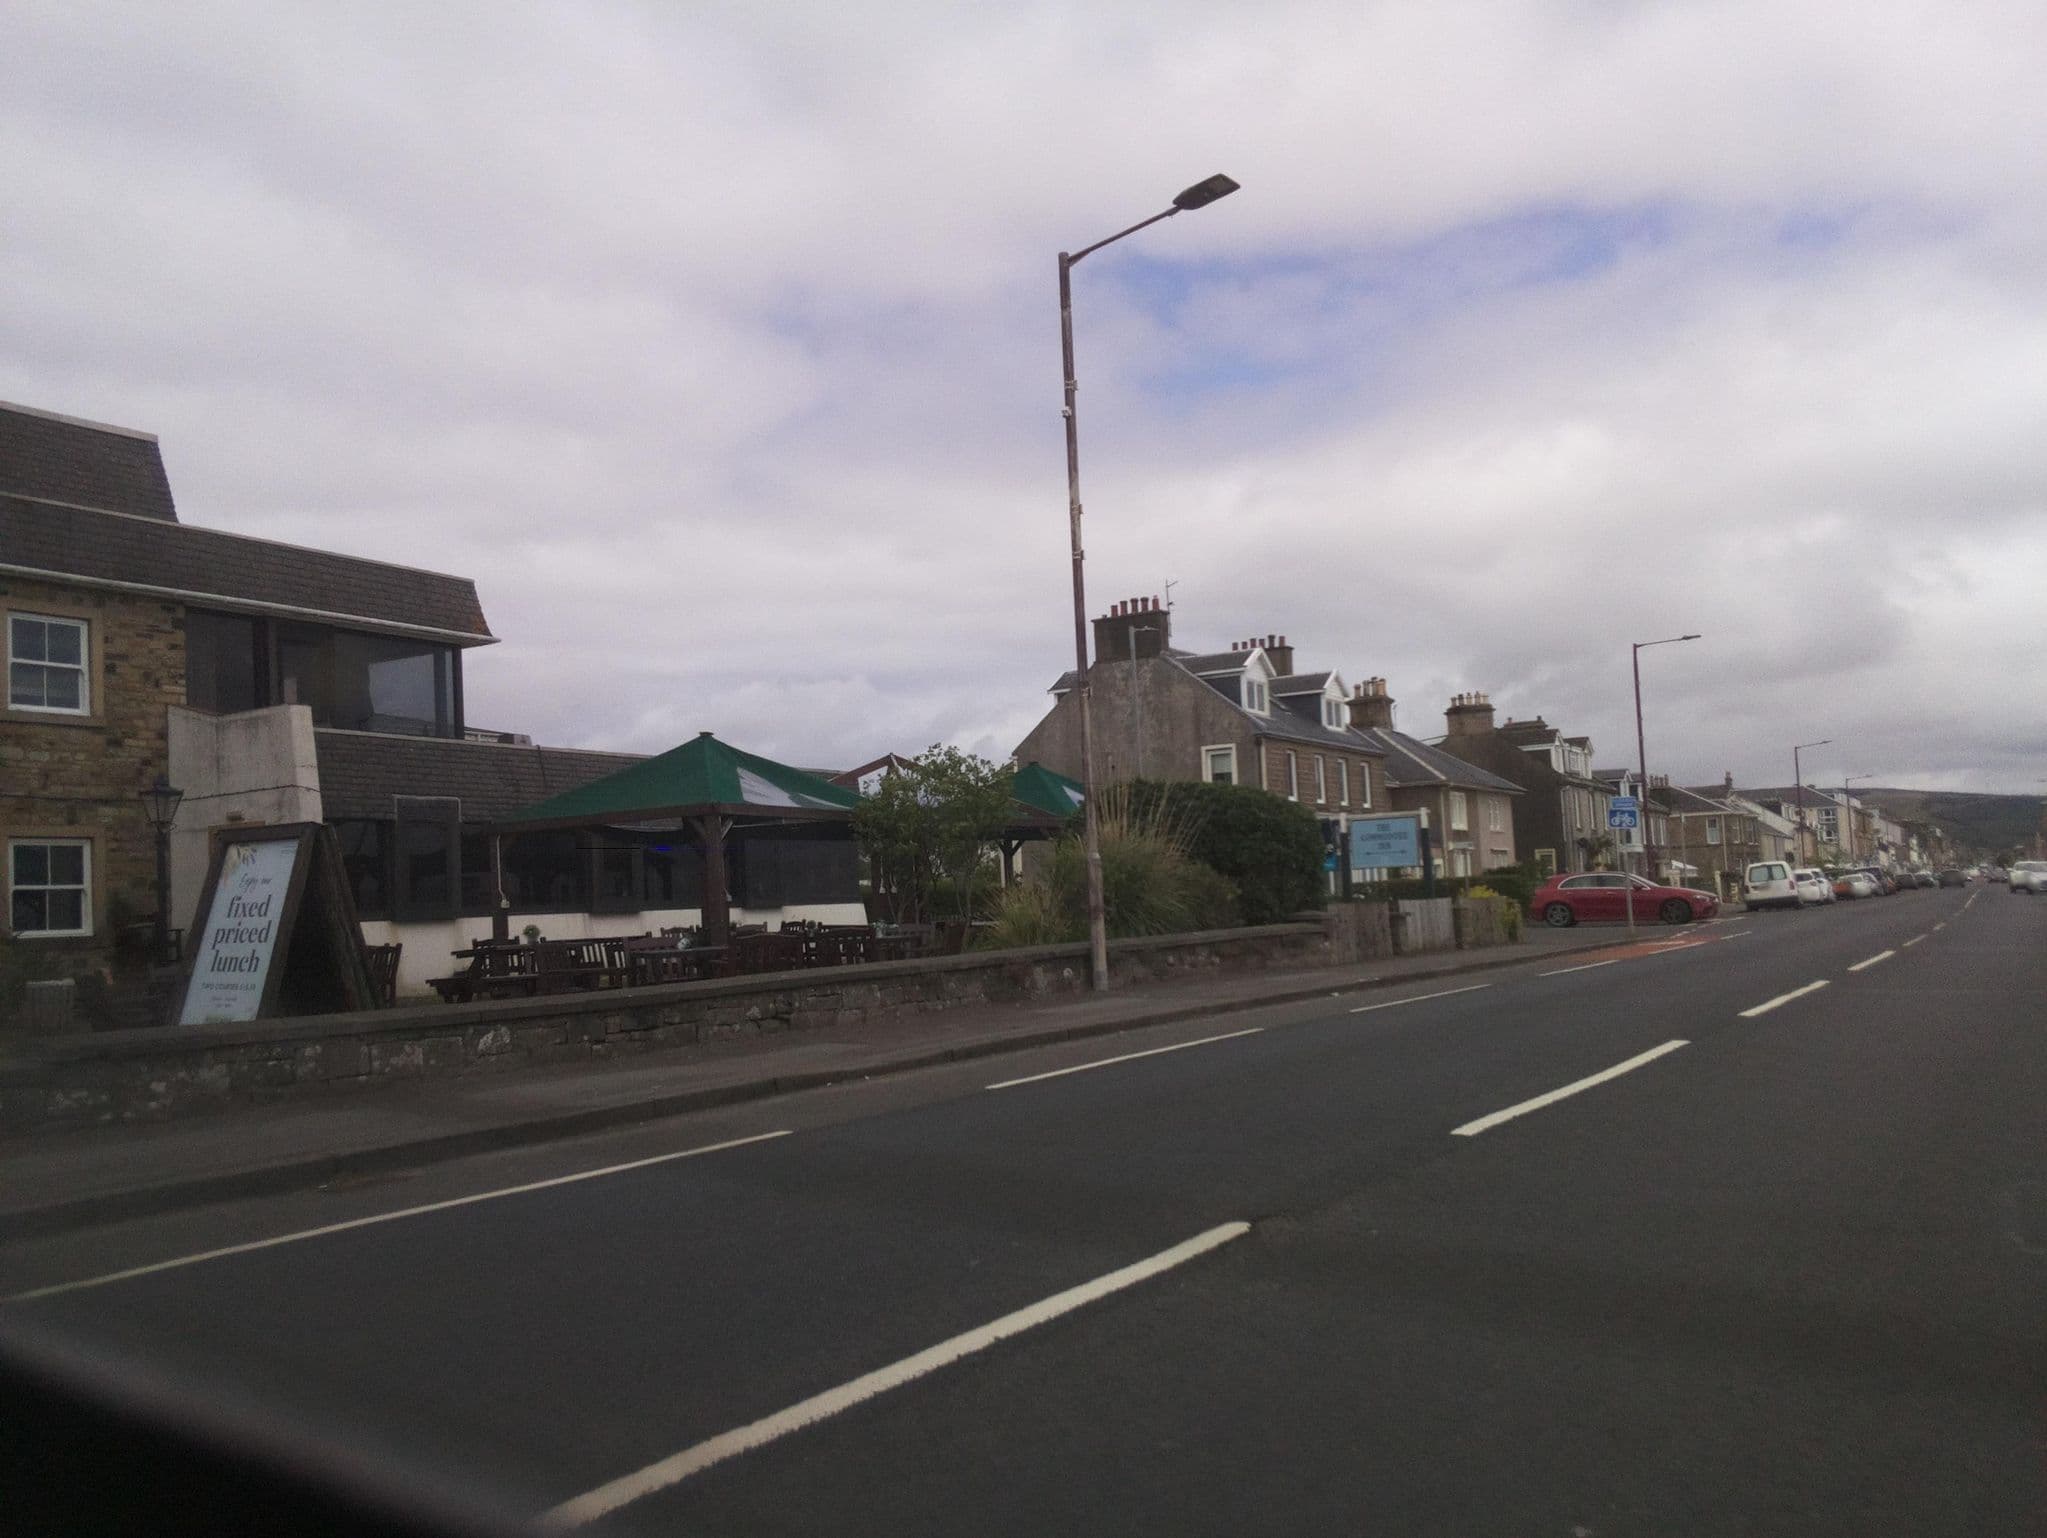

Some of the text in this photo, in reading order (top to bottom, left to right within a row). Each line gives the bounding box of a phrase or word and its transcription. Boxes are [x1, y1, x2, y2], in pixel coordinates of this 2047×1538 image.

[227, 894, 272, 919] fixed
[212, 920, 272, 950] priced
[210, 949, 260, 973] lunch
